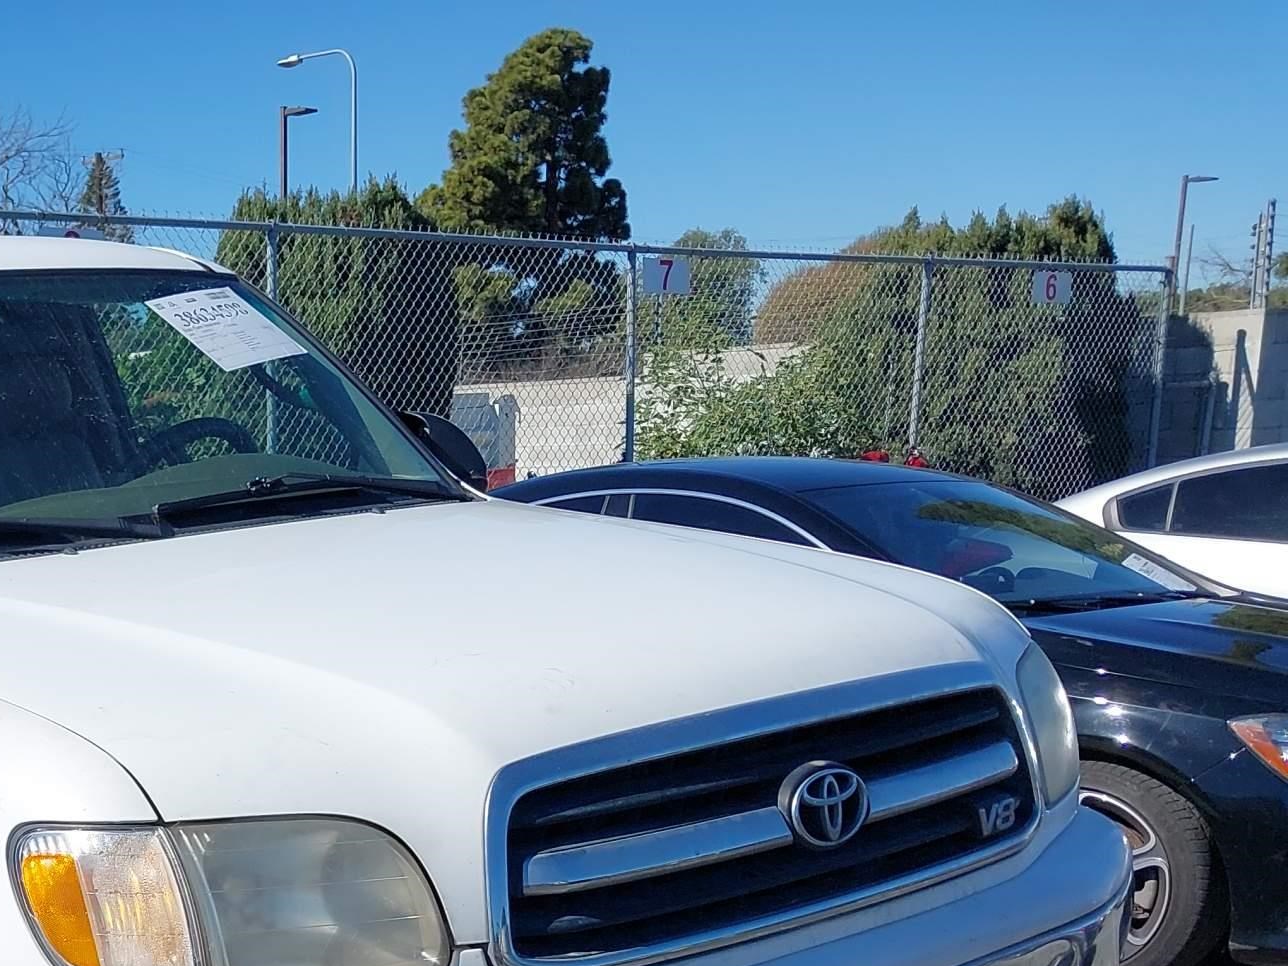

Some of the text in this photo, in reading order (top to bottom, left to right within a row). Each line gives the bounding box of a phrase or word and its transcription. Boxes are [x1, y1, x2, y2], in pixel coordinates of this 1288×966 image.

[659, 259, 674, 291] 7
[1045, 273, 1058, 301] 6
[978, 798, 1016, 838] V8
